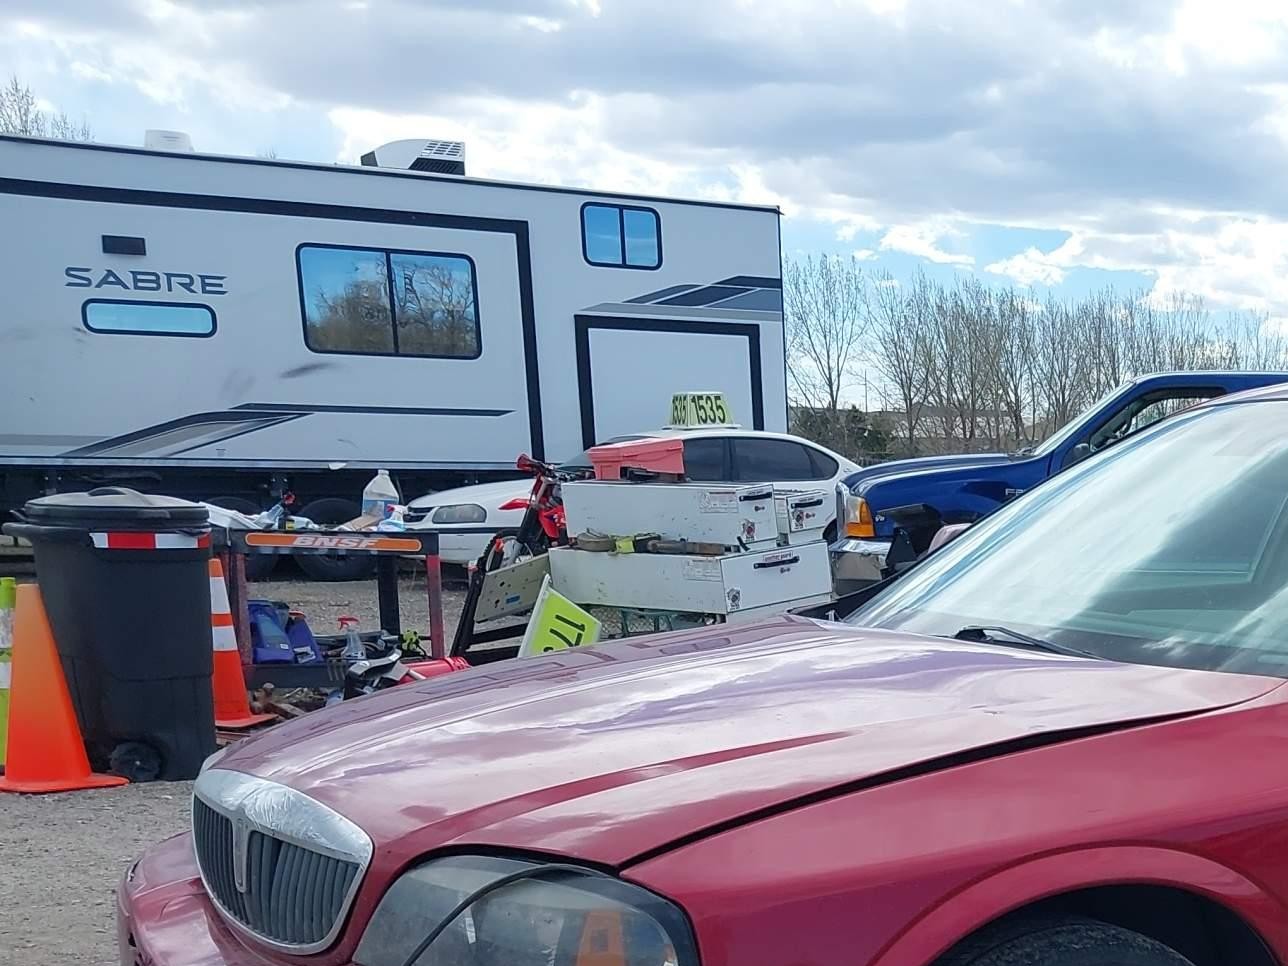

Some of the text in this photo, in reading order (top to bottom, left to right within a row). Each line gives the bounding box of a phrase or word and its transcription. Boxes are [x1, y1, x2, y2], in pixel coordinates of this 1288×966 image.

[64, 267, 229, 296] SABRE
[690, 395, 726, 424] 1535
[293, 536, 379, 548] BNSF
